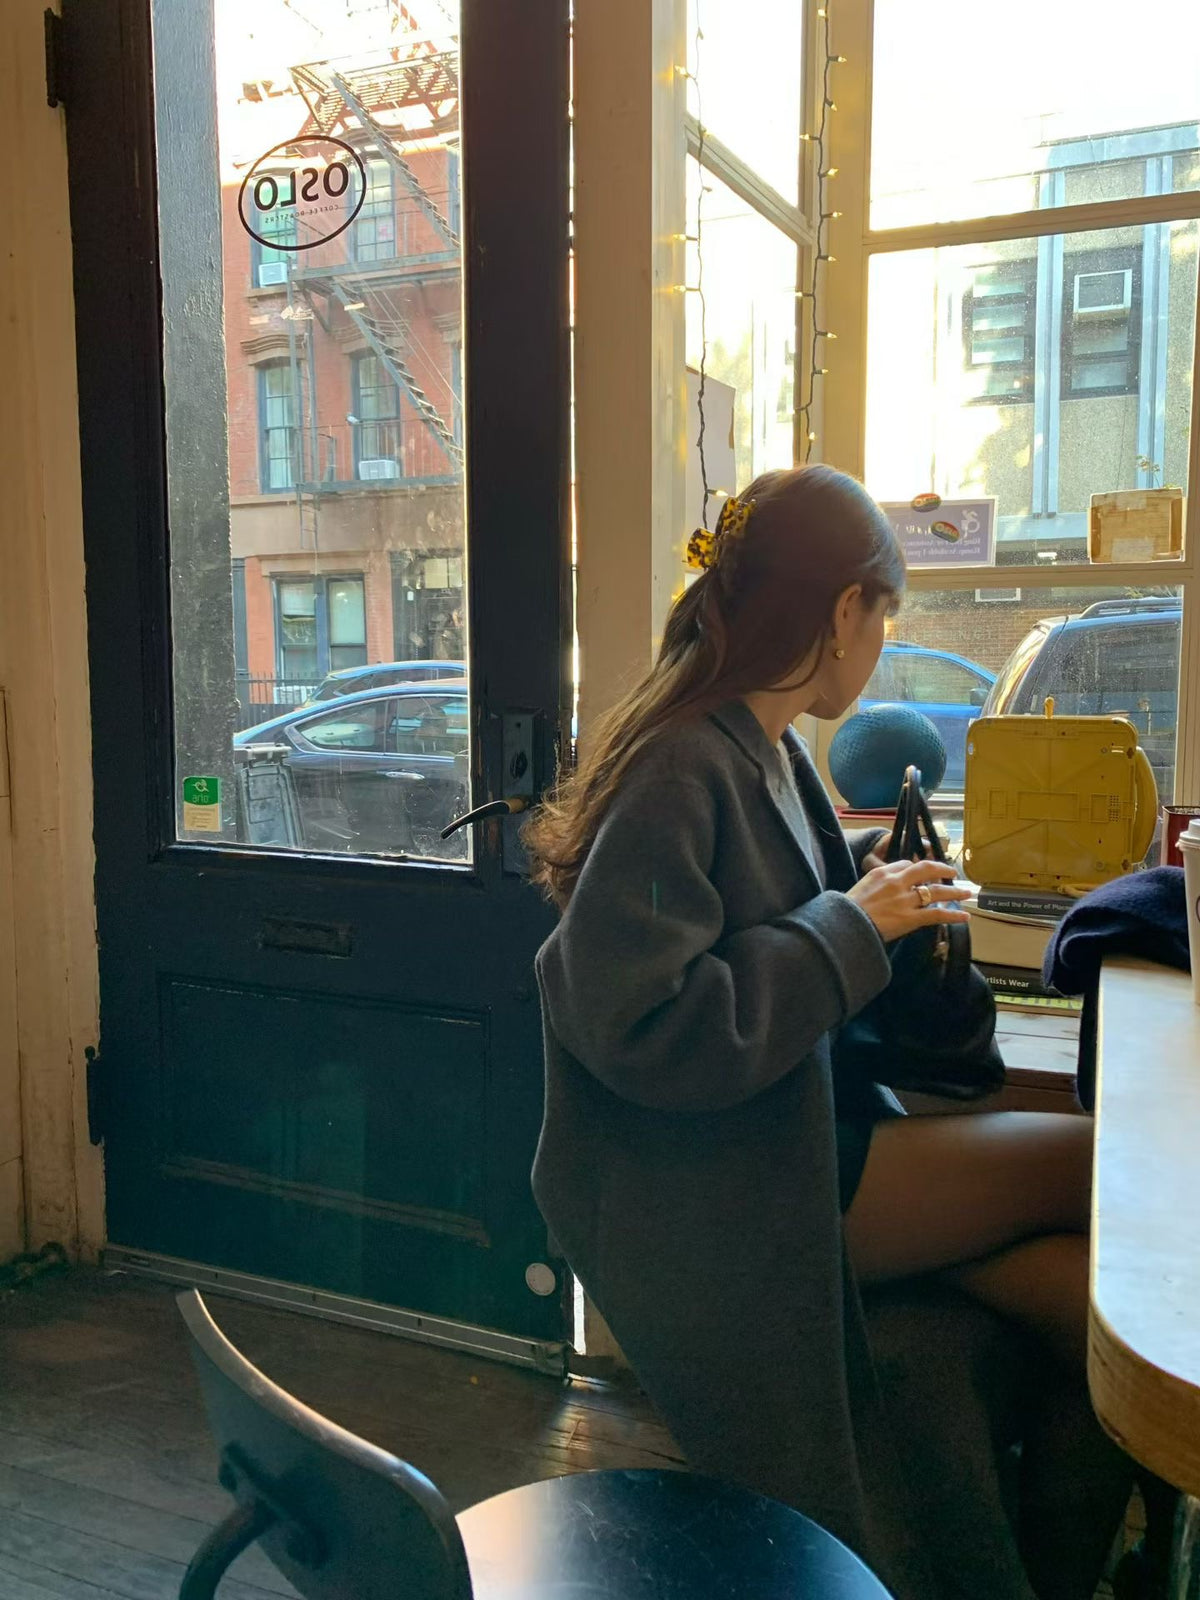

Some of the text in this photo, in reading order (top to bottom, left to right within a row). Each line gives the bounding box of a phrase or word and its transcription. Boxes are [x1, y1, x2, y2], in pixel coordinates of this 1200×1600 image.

[1011, 900, 1022, 908] the
[1023, 901, 1042, 909] Power
[1043, 902, 1051, 910] of
[984, 976, 1029, 988] rtists Wear
